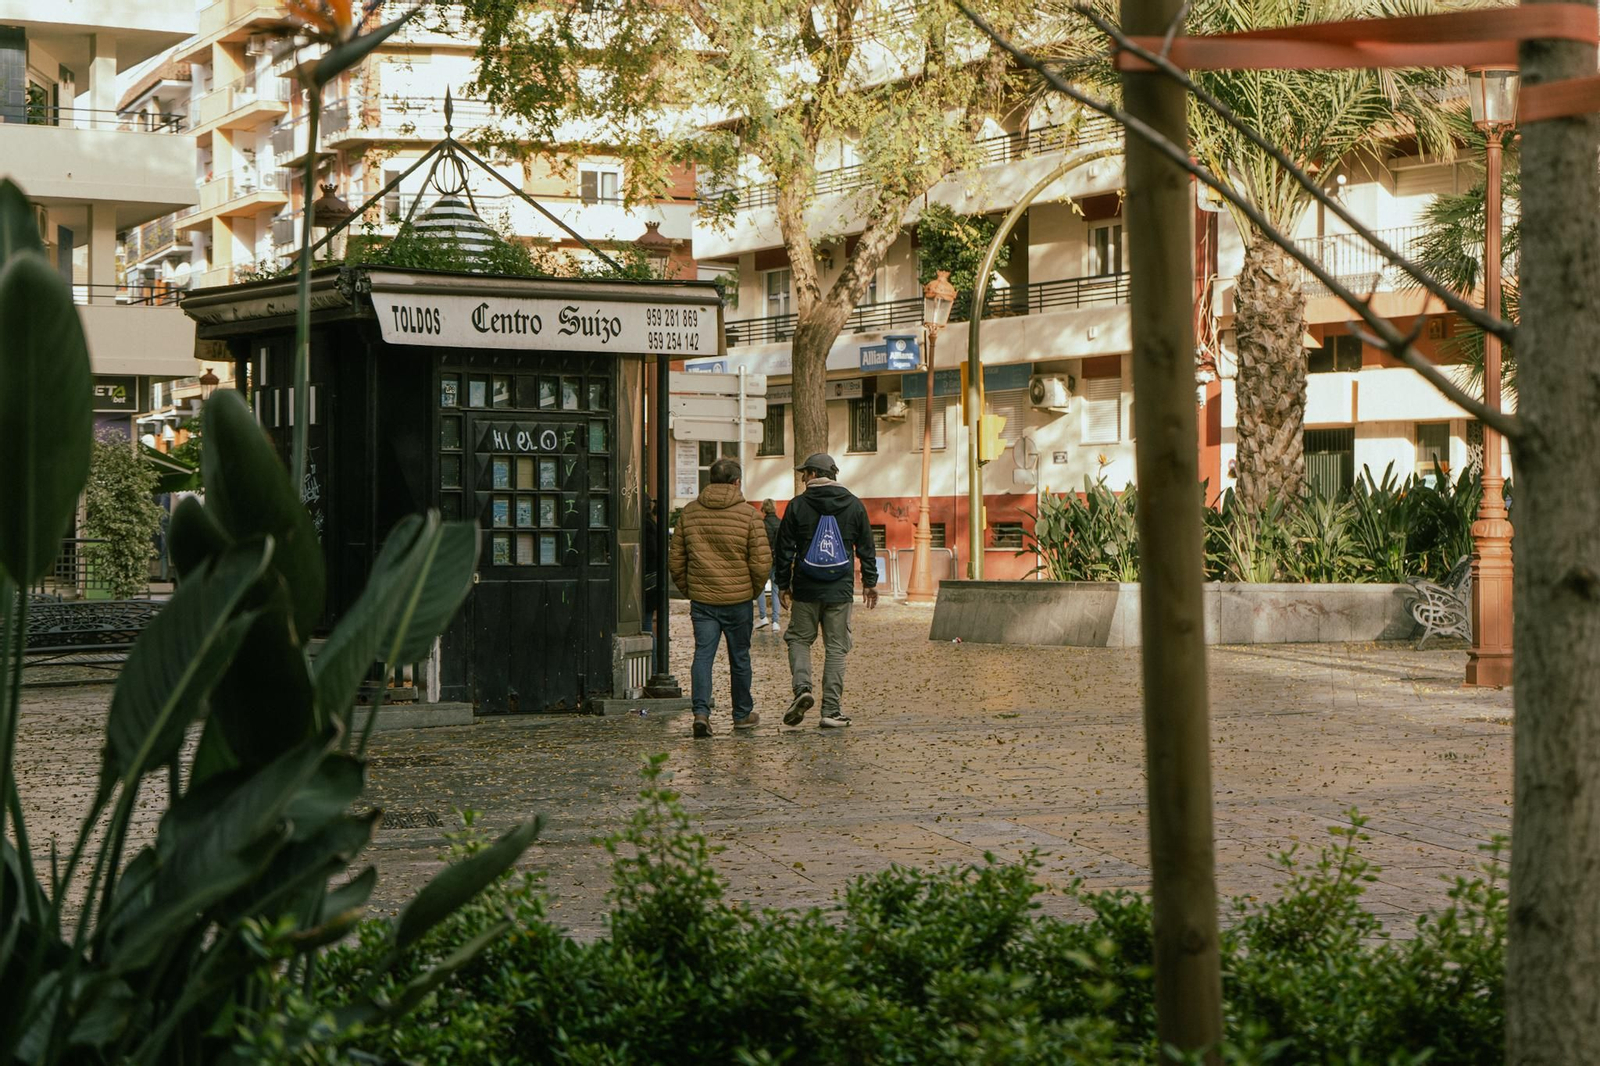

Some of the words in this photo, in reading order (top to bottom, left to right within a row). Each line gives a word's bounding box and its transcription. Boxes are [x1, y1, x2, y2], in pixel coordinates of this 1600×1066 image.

[391, 305, 441, 335] TOLDOS
[471, 302, 542, 335] Centro
[646, 308, 662, 327] 959
[664, 308, 680, 327] 281
[682, 309, 698, 328] 869
[648, 332, 664, 350] 959
[666, 332, 682, 350] 254
[684, 333, 699, 351] 142
[862, 350, 888, 366] Allian
[889, 351, 915, 360] Allianz
